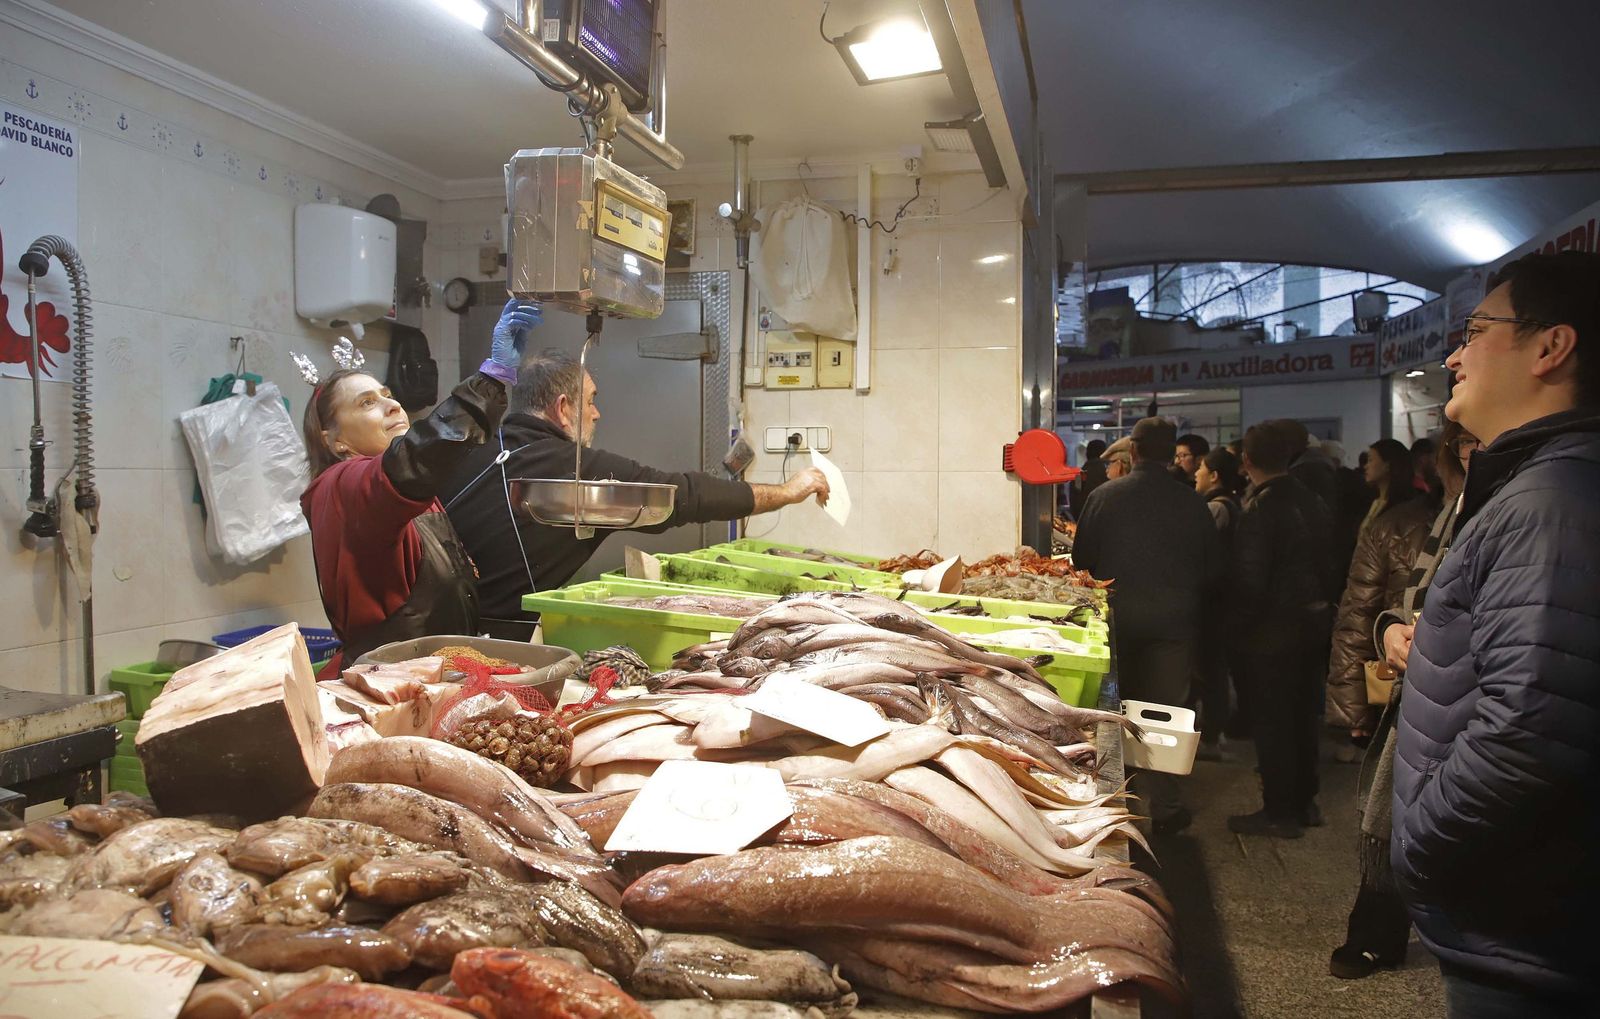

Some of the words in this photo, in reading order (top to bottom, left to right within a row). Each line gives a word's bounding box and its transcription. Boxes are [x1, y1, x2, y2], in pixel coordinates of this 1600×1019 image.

[0, 126, 28, 143] AVID
[30, 135, 74, 157] BLANCO
[4, 111, 73, 143] PESCADERÍA
[1196, 352, 1334, 380] Auxiliadora
